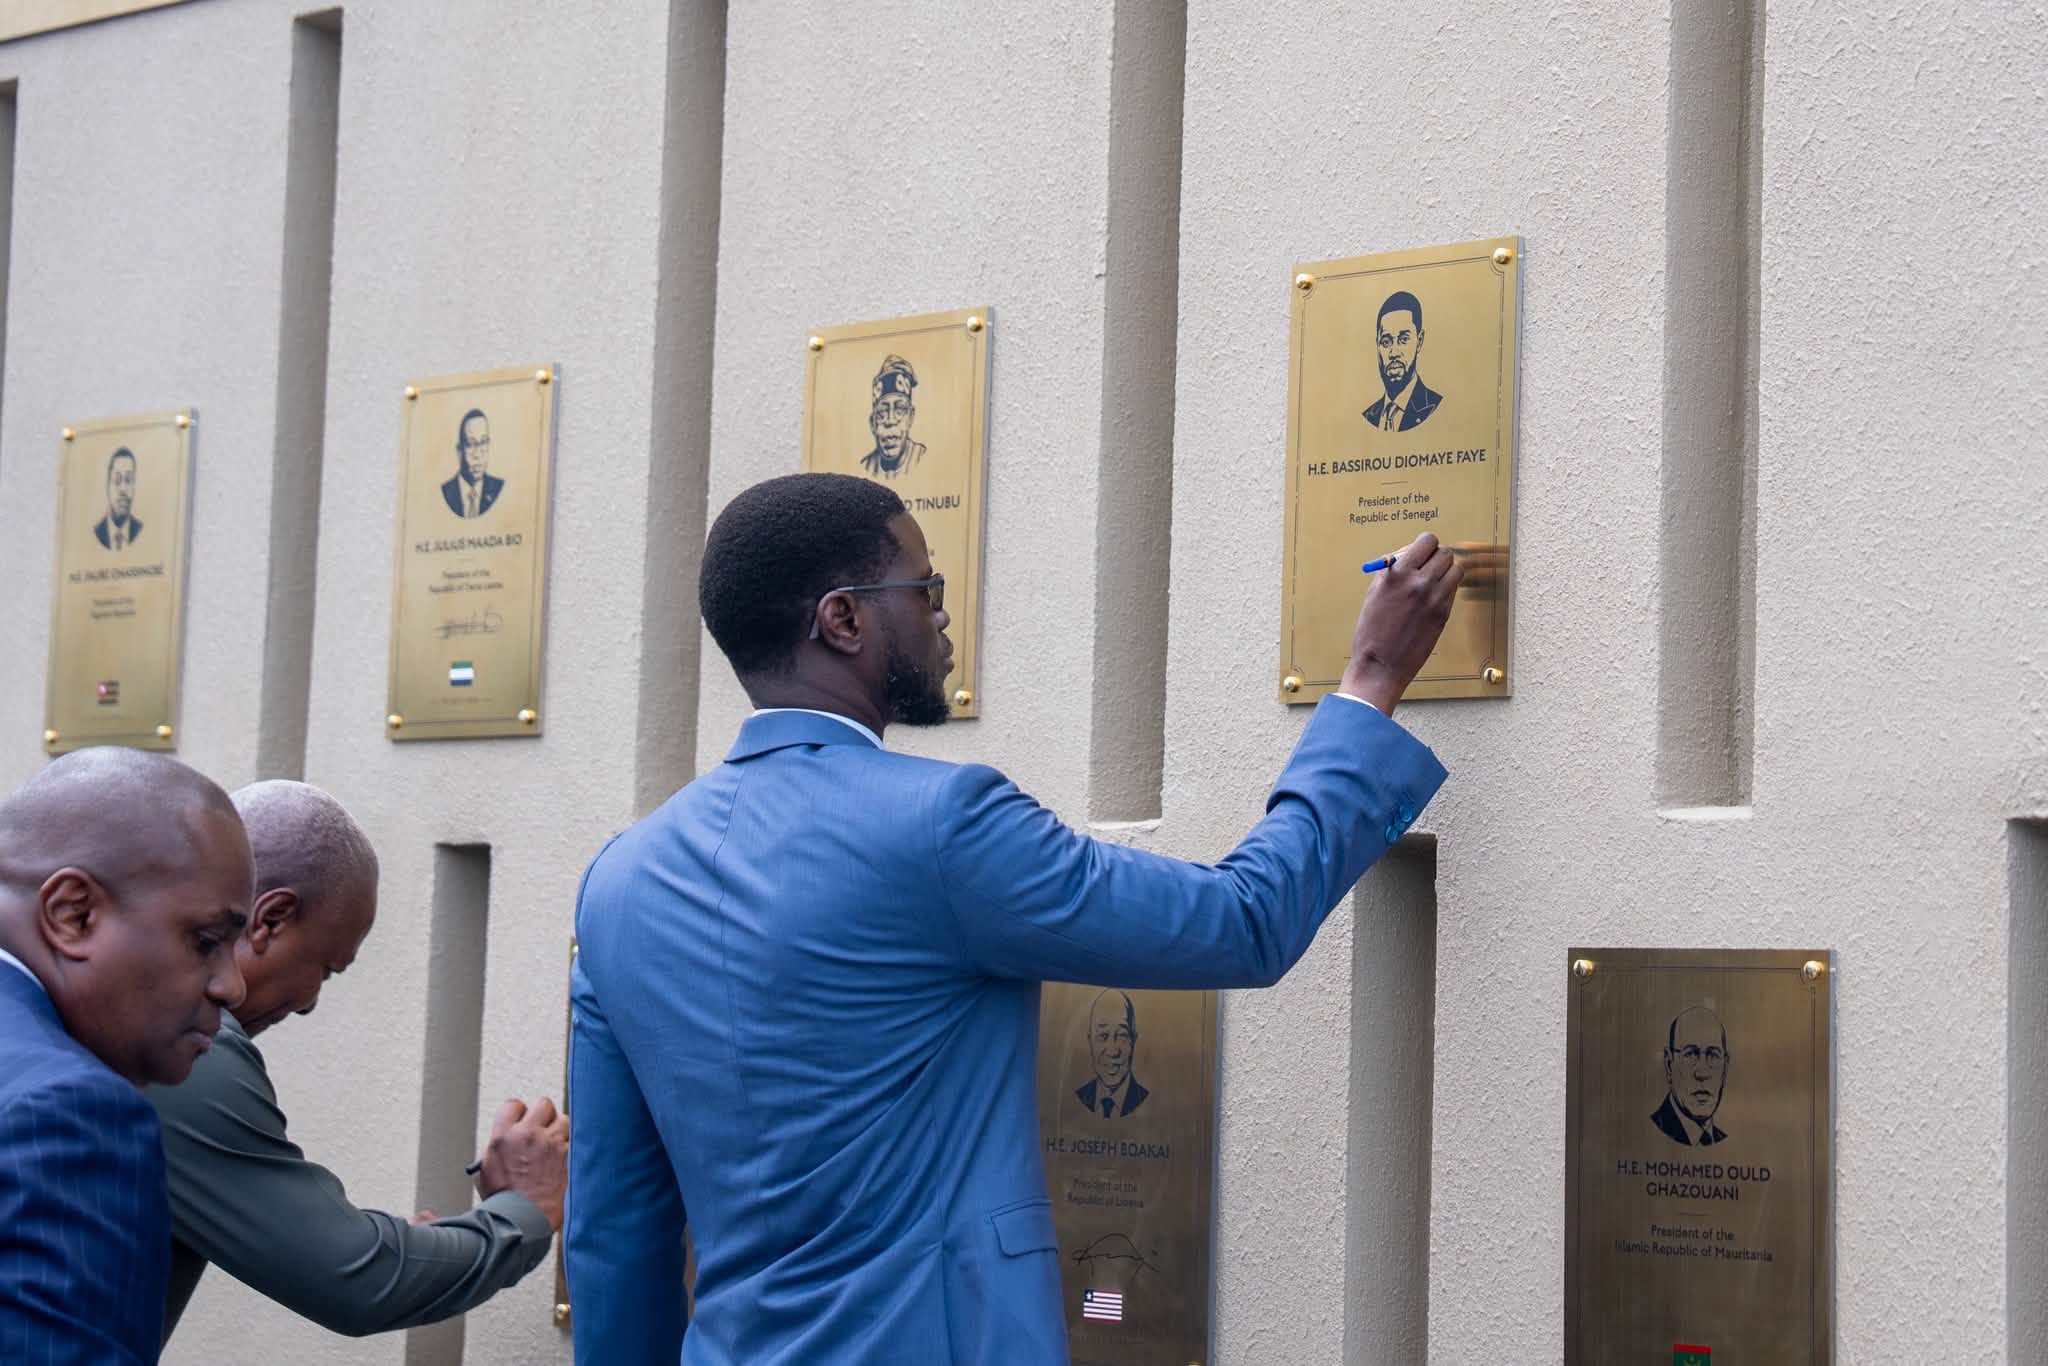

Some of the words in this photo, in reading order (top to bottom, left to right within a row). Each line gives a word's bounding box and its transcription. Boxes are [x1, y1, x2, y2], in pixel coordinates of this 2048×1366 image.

[1308, 463, 1329, 476] H.E.
[1332, 456, 1391, 474] BASSIROU
[1395, 451, 1453, 468] DIOMAYE
[1456, 449, 1486, 463] FAYE
[915, 494, 960, 511] TINUBU
[1358, 495, 1400, 507] President
[1402, 493, 1413, 504] of
[1414, 492, 1430, 503] the
[1350, 511, 1389, 524] Republic
[1390, 510, 1401, 521] of
[1403, 508, 1438, 522] Senegal
[1046, 1138, 1066, 1152] H.E.
[1071, 1139, 1117, 1156] JOSEPH
[1120, 1142, 1170, 1158] BOAKAI
[1617, 1160, 1642, 1175] H.E.
[1646, 1162, 1724, 1180] MOHAMED
[1727, 1166, 1771, 1182] OULD
[1646, 1182, 1740, 1200] GHAZOUANI
[1651, 1224, 1700, 1239] President
[1702, 1227, 1714, 1240] of
[1716, 1227, 1735, 1241] the
[1615, 1240, 1649, 1254] Islamic
[1652, 1242, 1698, 1257] Republic
[1700, 1244, 1712, 1257] of
[1715, 1247, 1773, 1262] Mauritania
